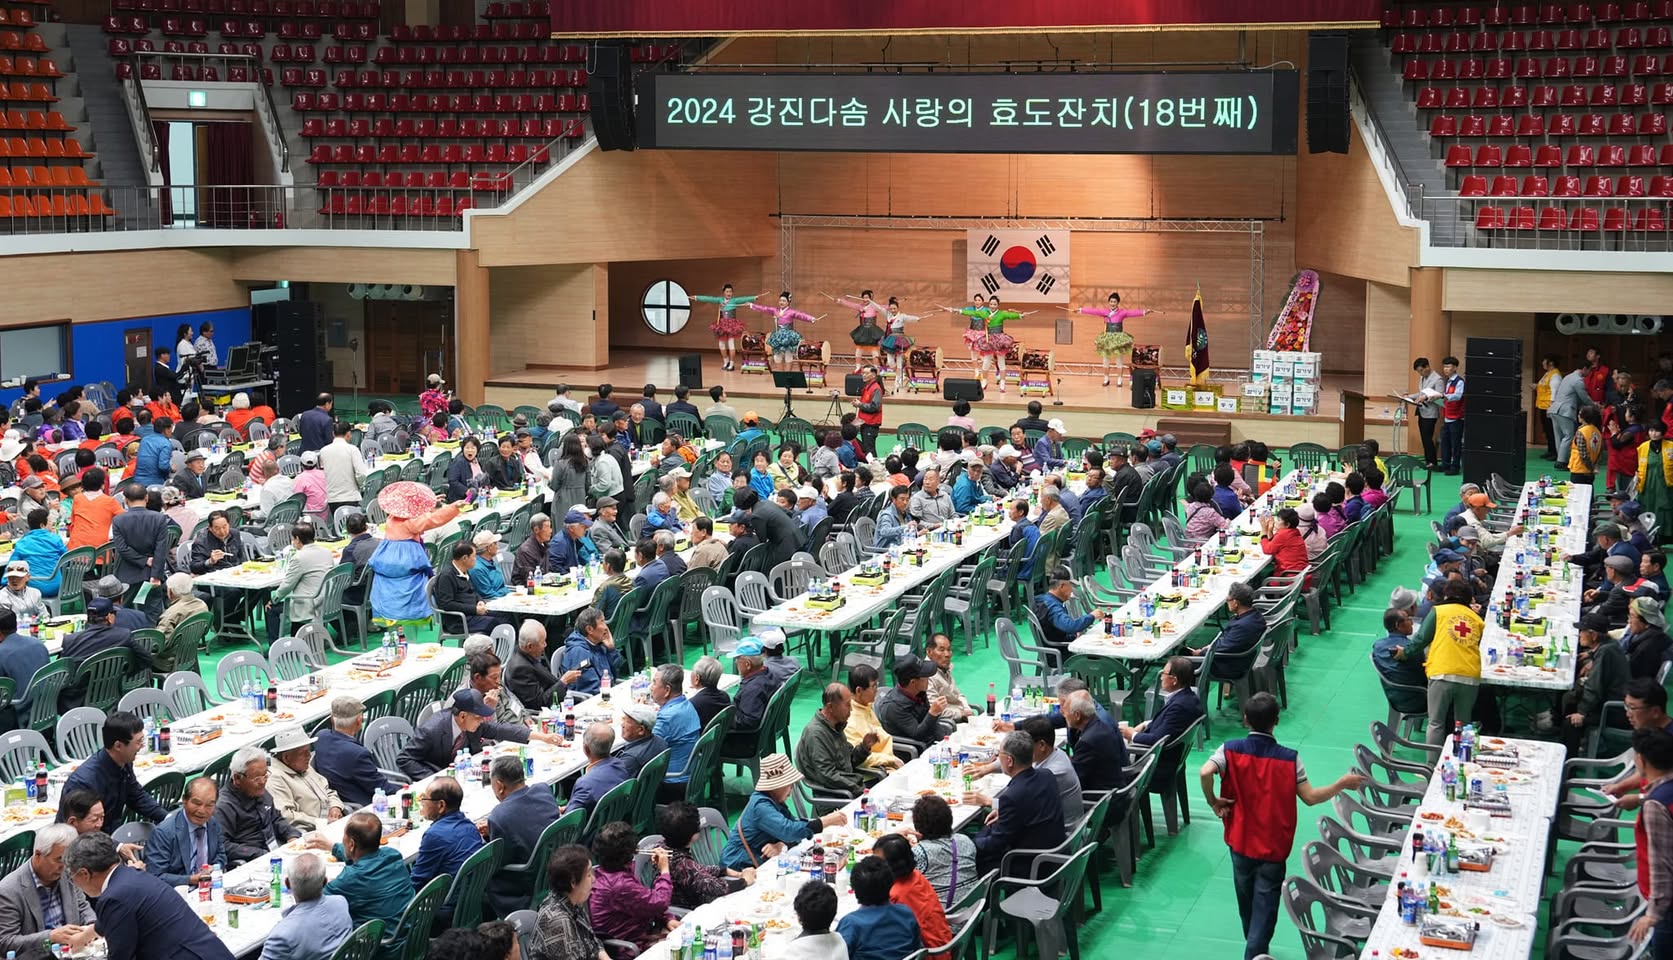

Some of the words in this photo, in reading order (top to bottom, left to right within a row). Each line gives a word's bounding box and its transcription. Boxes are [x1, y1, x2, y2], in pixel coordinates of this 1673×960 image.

[667, 97, 736, 123] 2024
[748, 97, 869, 126] 강진다솜
[882, 98, 972, 127] 사랑의
[989, 95, 1258, 129] 효도잔치(18번째)
